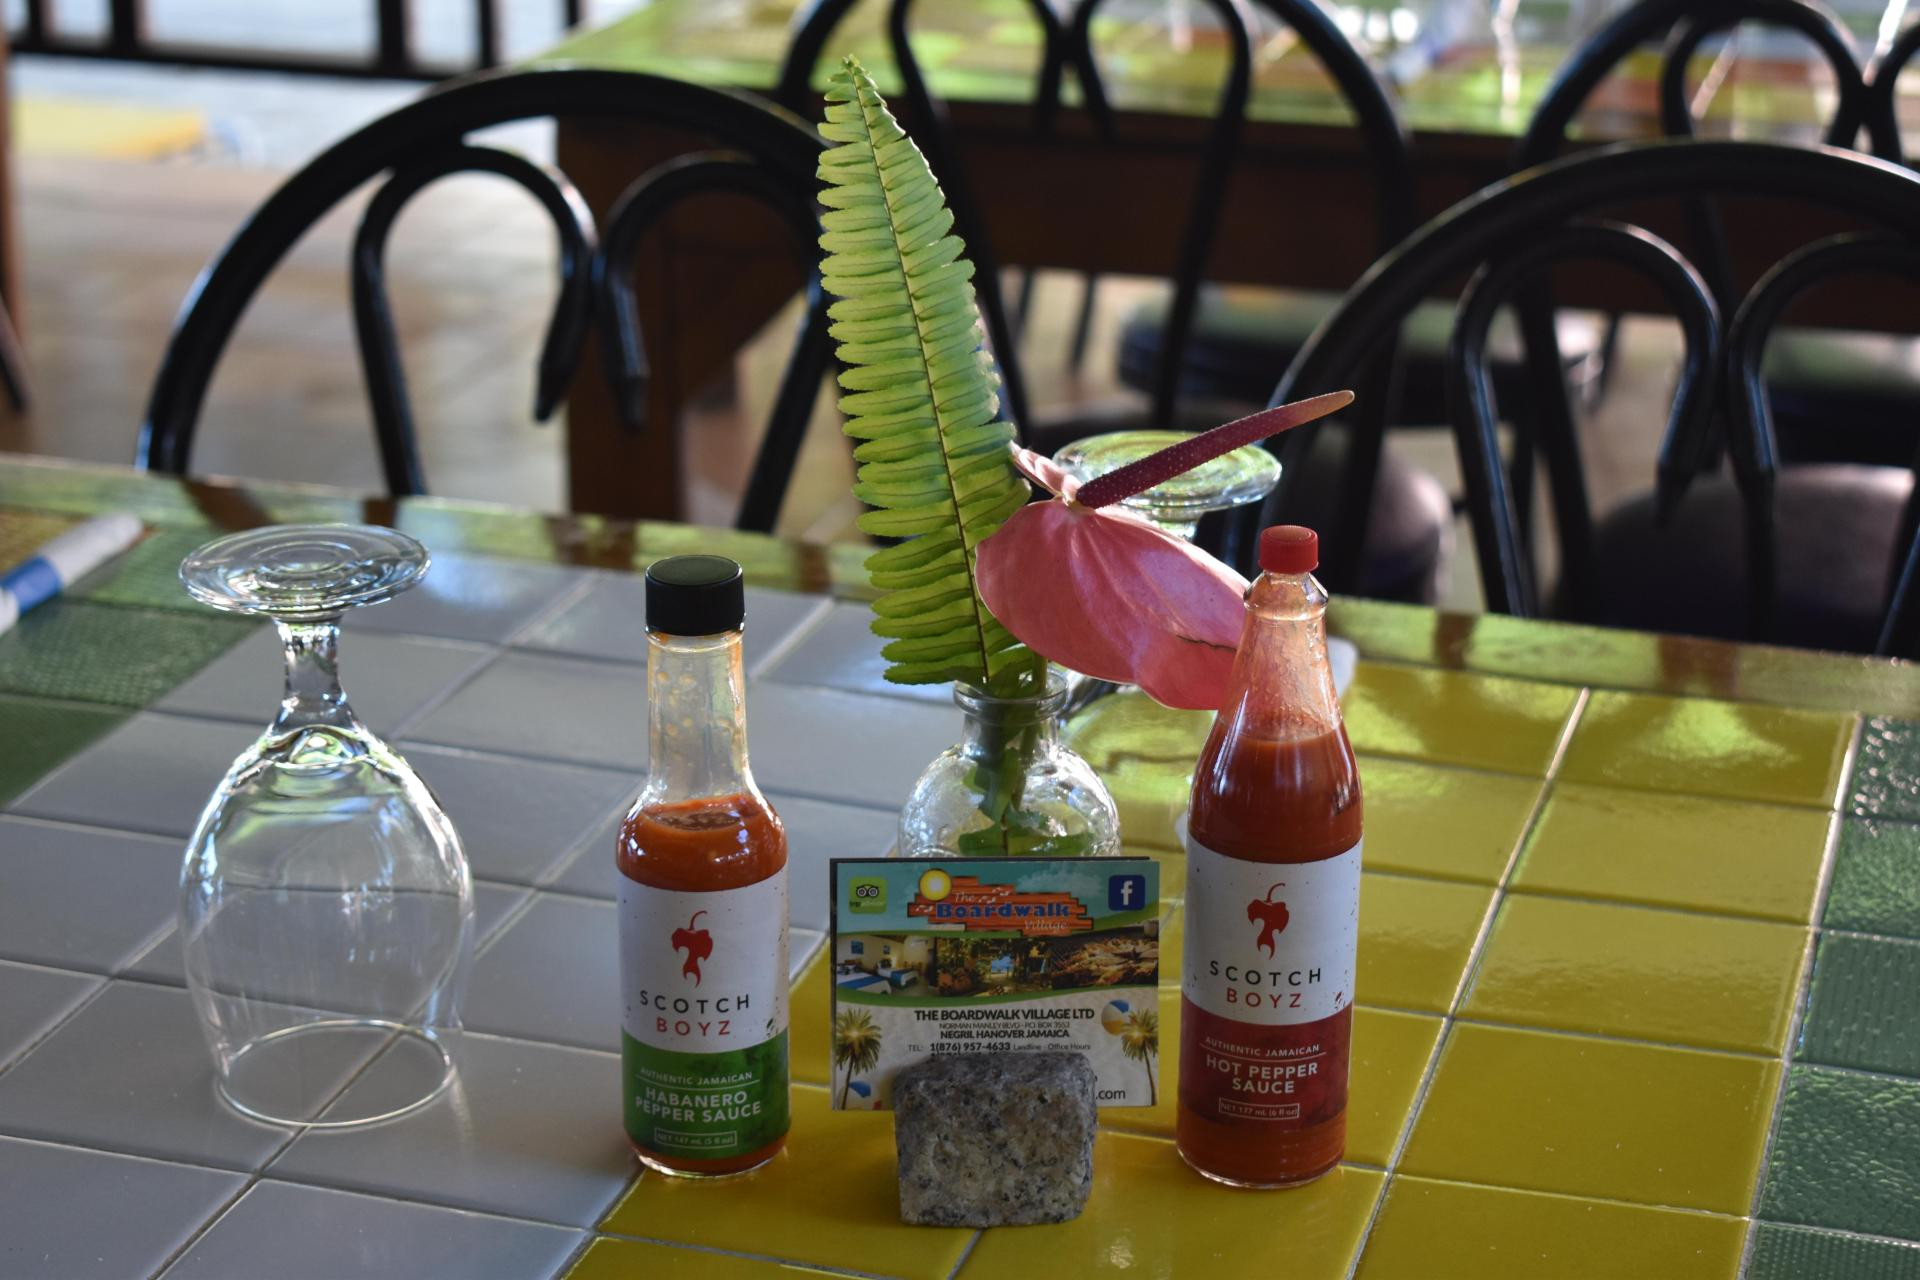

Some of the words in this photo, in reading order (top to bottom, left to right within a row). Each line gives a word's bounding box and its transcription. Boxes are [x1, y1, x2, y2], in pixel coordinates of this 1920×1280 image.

[936, 902, 1070, 918] Boardwalk
[1210, 960, 1322, 987] SCOTCH
[640, 990, 750, 1014] SCOTCH
[1226, 987, 1302, 1009] BOYZ
[914, 1009, 939, 1021] THE
[940, 1009, 1020, 1021] BOARDWALK
[1021, 1008, 1071, 1020] VILLAGE
[1072, 1008, 1095, 1019] LTD
[656, 1017, 731, 1037] BOYZ
[940, 1030, 975, 1039] NEGRIL
[976, 1029, 1025, 1039] HANOVER
[1026, 1029, 1070, 1038] JAMAICA
[930, 1042, 961, 1054] 1(876)
[963, 1042, 1011, 1051] 957-4633
[1205, 1036, 1261, 1056] AUTHENTIC
[1265, 1043, 1320, 1057] JAMAICAN
[640, 1066, 693, 1085] AUTHENTIC
[697, 1071, 753, 1086] JAMAICAN
[1206, 1054, 1242, 1076] HOT
[1249, 1062, 1318, 1081] PEPPER
[1232, 1078, 1295, 1094] SAUCE
[645, 1086, 748, 1108] HABANERO
[635, 1095, 695, 1122] PEPPER
[702, 1101, 762, 1123] SAUCE
